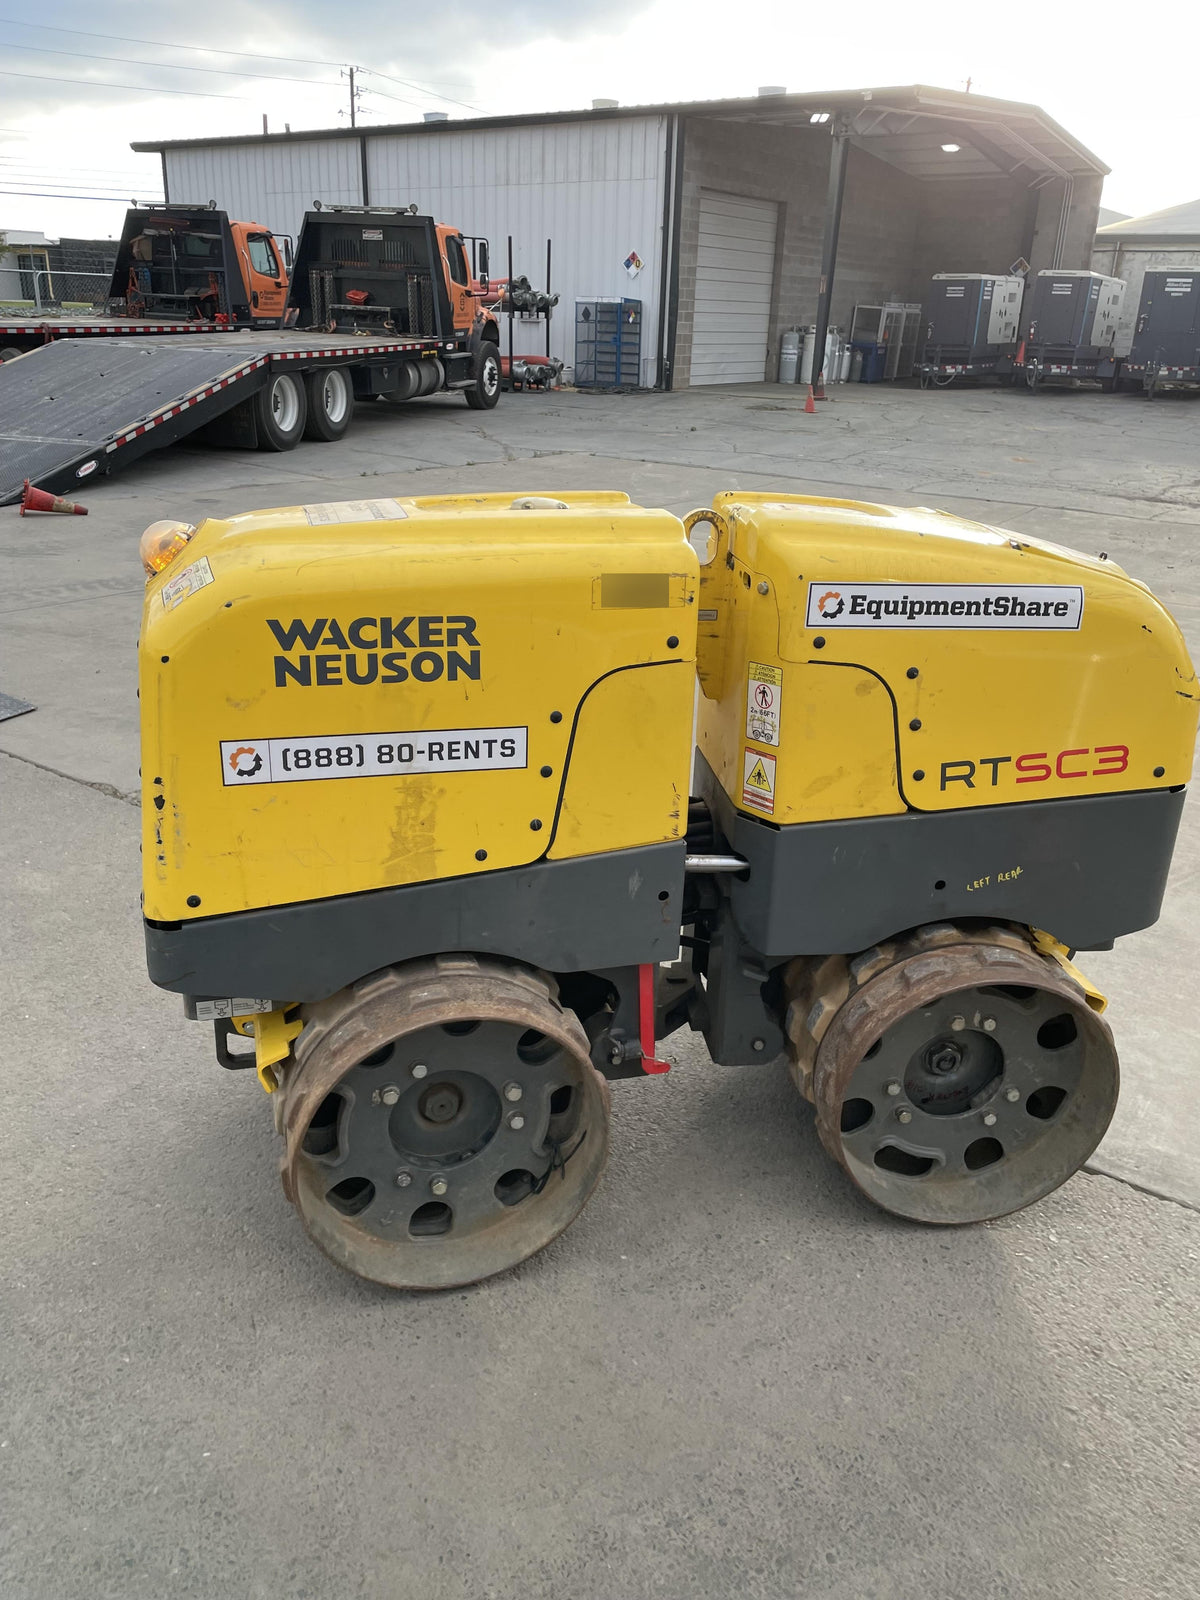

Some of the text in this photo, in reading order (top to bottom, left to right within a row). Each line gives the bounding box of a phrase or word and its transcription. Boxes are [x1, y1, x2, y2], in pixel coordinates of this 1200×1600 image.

[849, 594, 1069, 620] EquipmentShare
[265, 615, 481, 651] WACKER
[273, 650, 481, 687] NEUSON
[281, 738, 516, 772] (888) 80-RENTS
[939, 744, 1130, 791] RTSC3
[966, 865, 1024, 892] LEFT REAR
